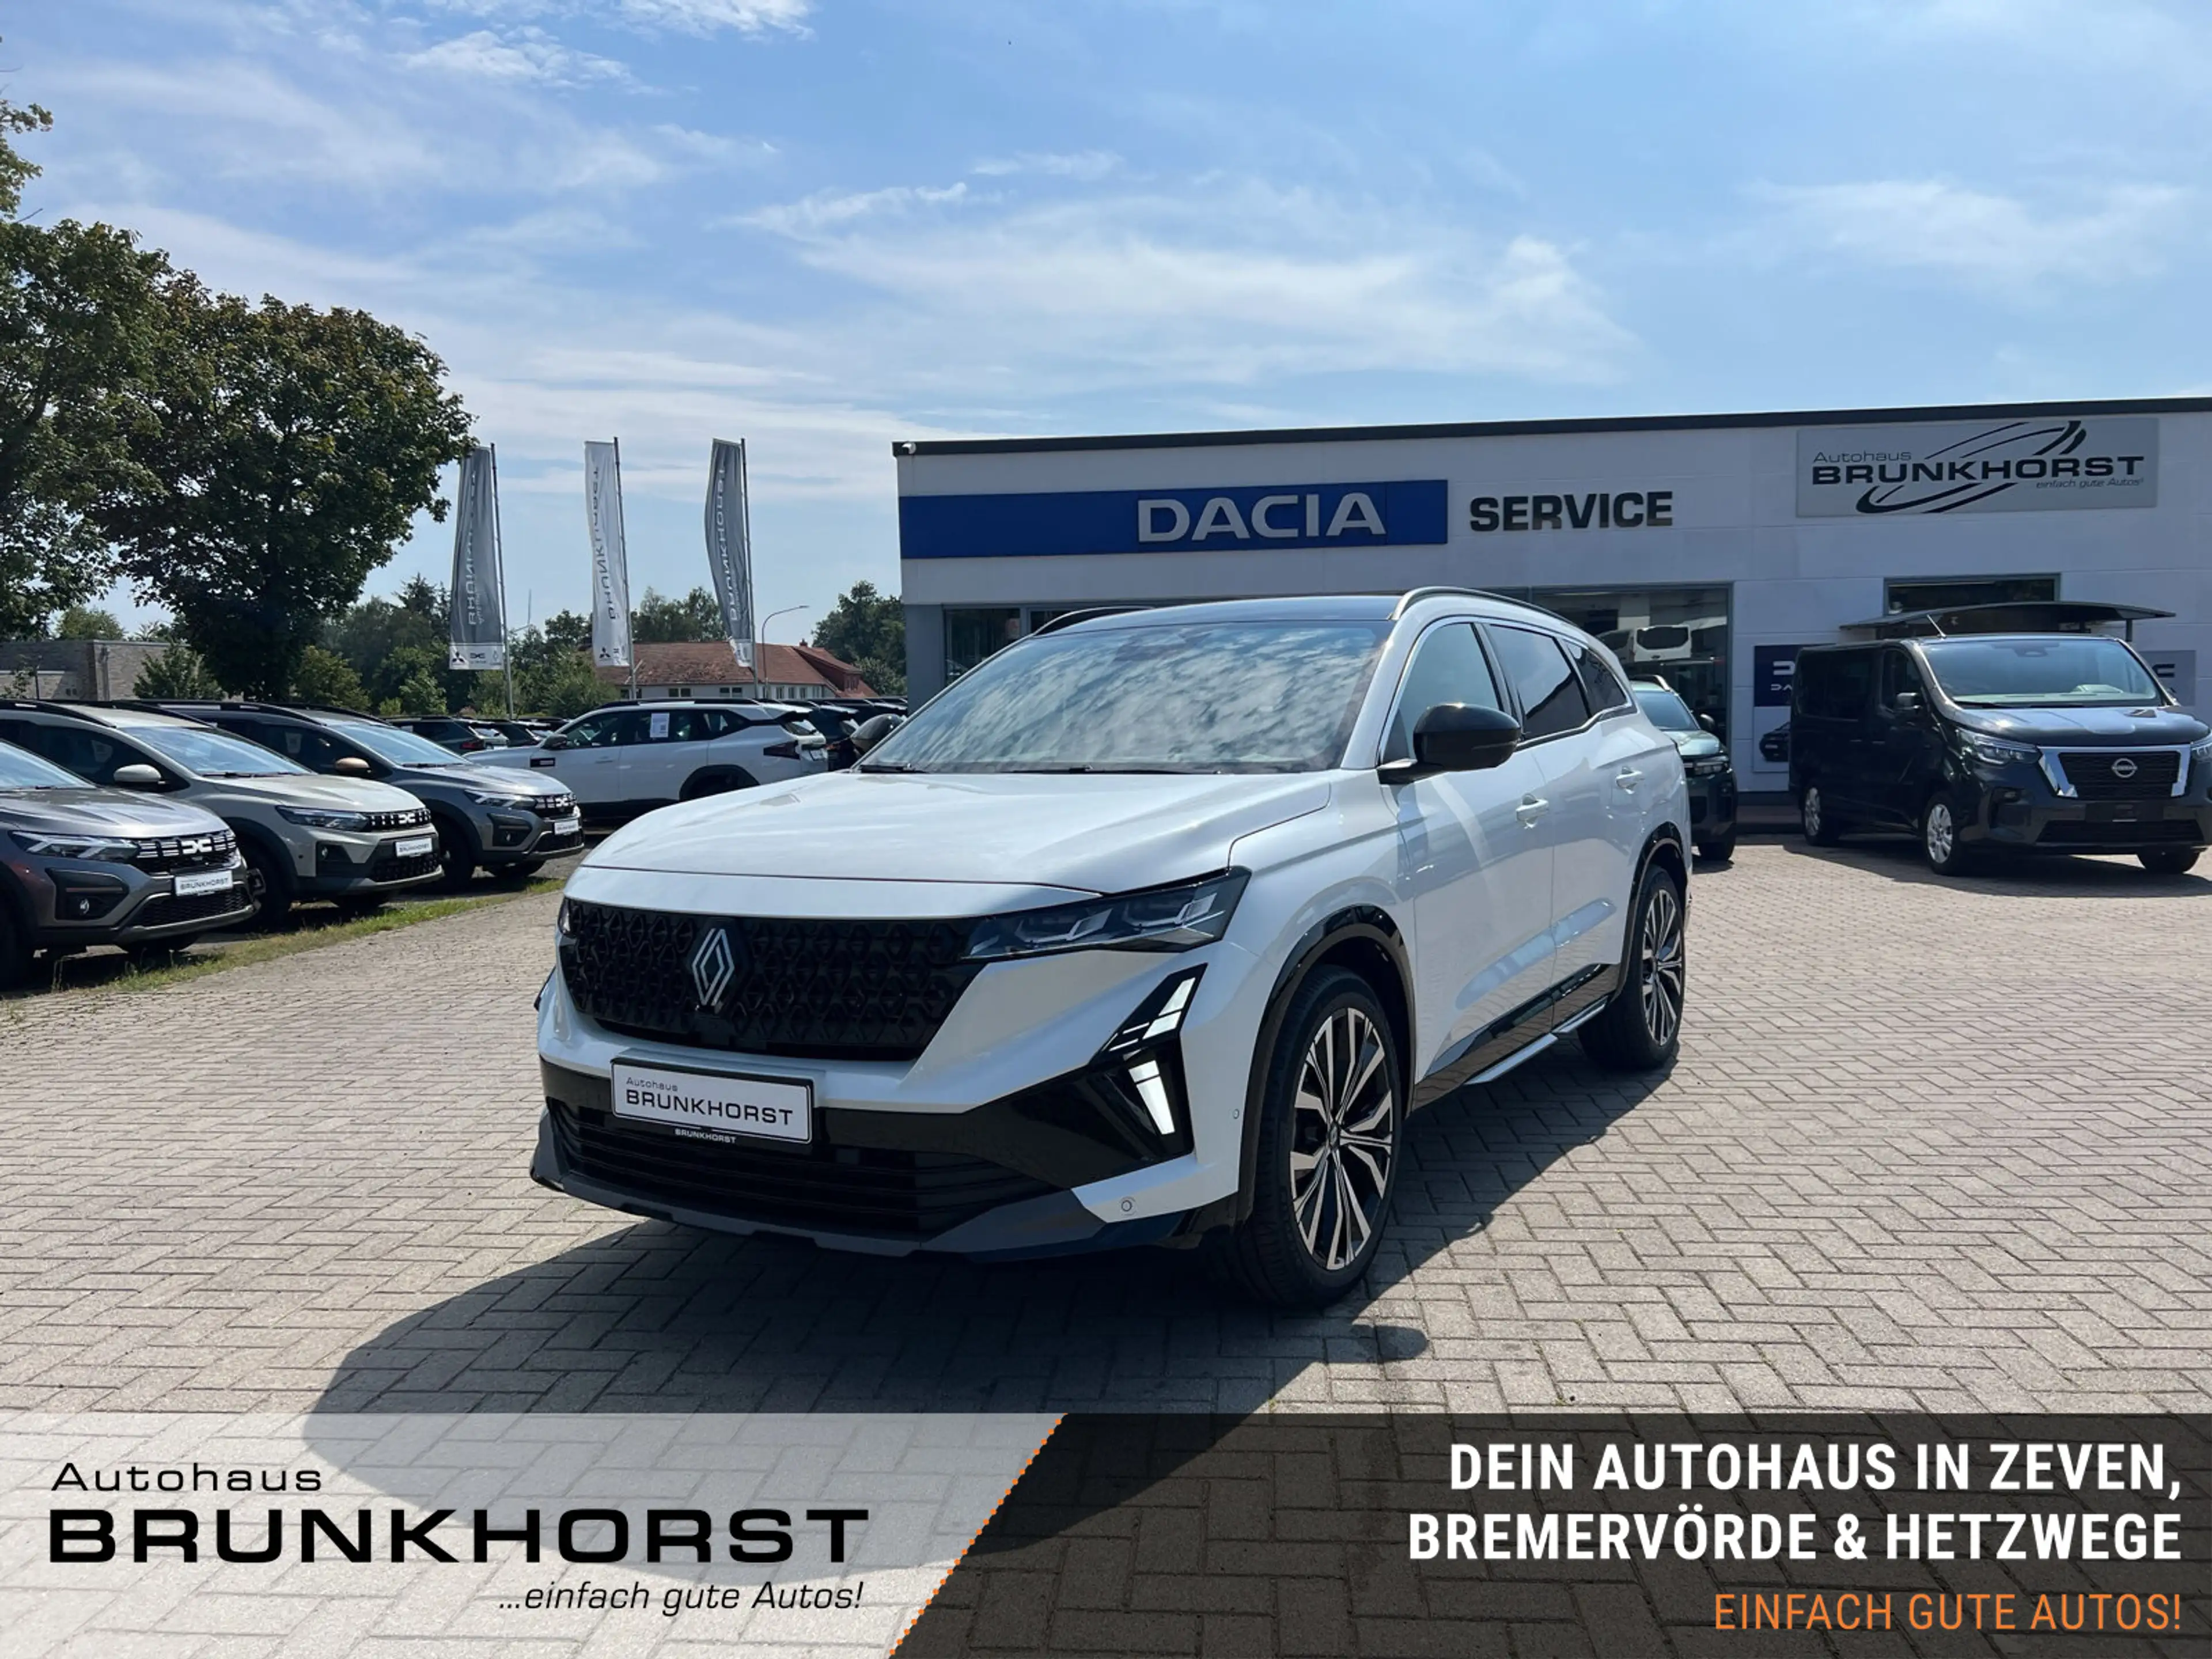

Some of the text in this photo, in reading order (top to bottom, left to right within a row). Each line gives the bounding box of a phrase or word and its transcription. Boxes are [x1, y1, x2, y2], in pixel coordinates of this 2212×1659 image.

[1812, 456, 2145, 485] BRUNKHORST
[1813, 450, 1912, 463] Autohaus
[1138, 492, 1387, 542] DACIA
[1470, 491, 1673, 532] SERVICE
[626, 1077, 679, 1092] Autohaus
[626, 1089, 793, 1125] BRUNKHORST
[675, 1128, 737, 1144] BRUNKHORST
